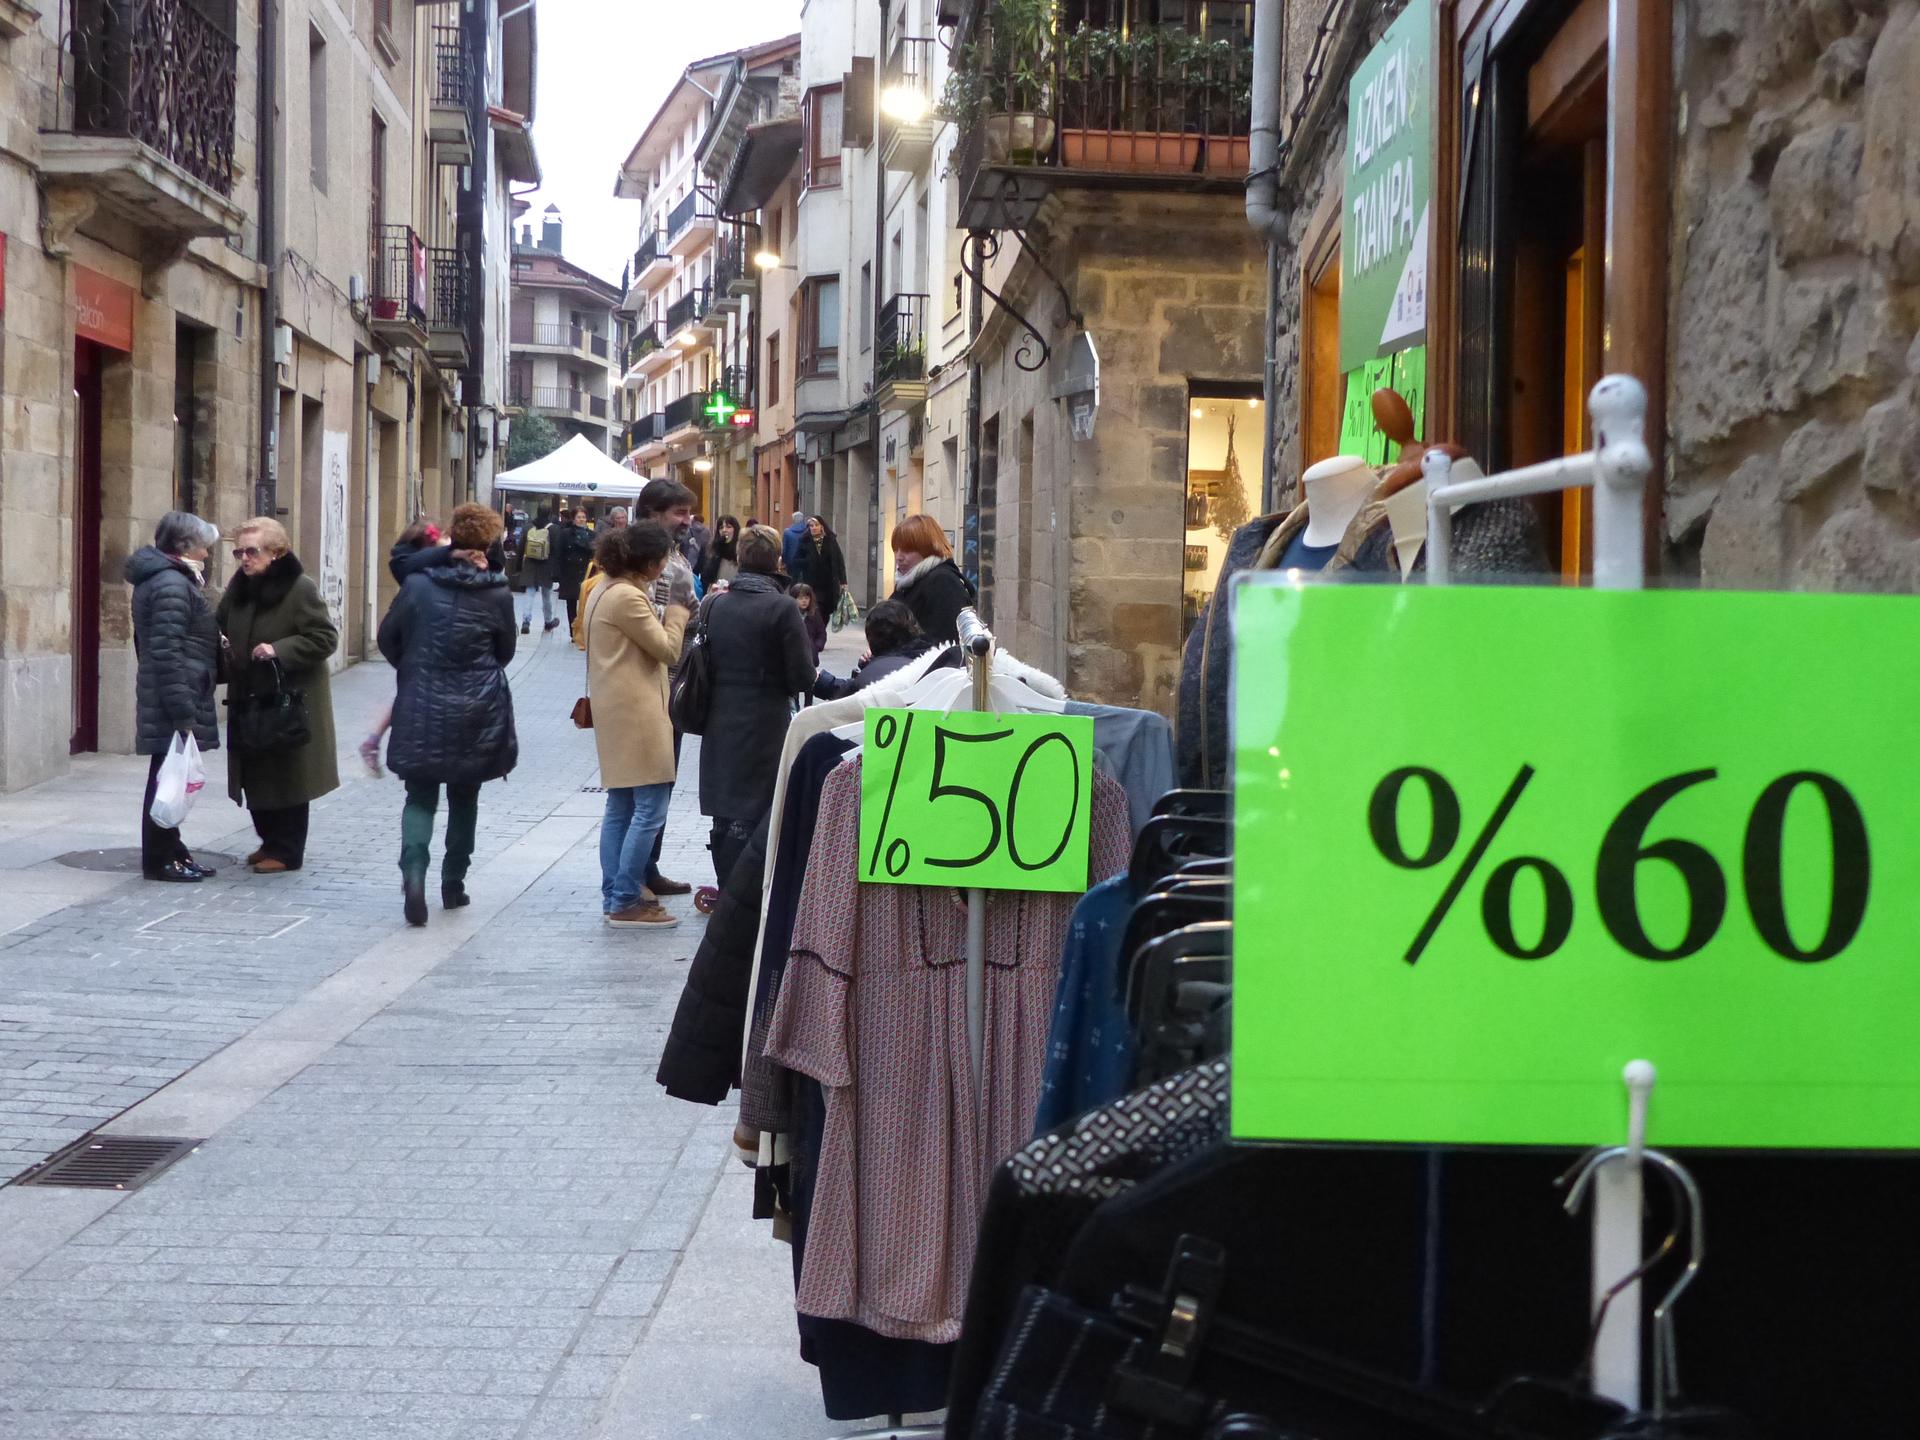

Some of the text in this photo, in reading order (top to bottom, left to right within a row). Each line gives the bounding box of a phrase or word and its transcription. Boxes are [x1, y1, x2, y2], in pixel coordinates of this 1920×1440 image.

[1353, 36, 1410, 176] AZKEN
[1353, 155, 1414, 278] TXANPA
[869, 712, 1080, 878] %50
[1367, 762, 1871, 966] %60
